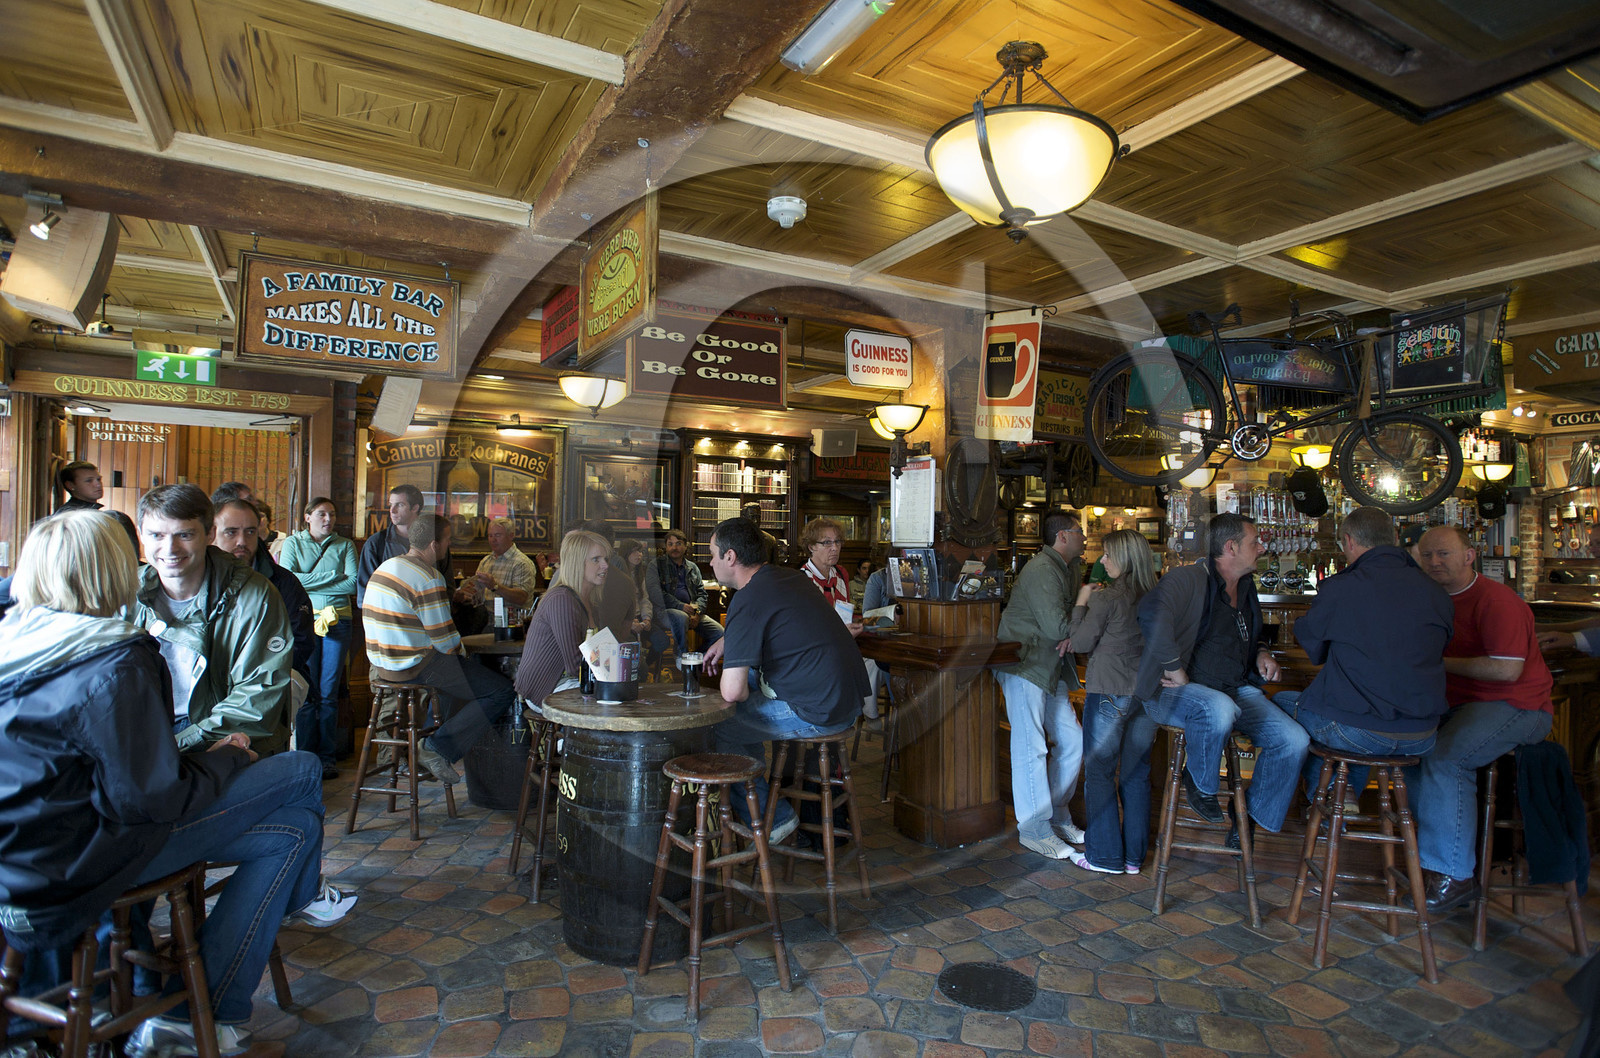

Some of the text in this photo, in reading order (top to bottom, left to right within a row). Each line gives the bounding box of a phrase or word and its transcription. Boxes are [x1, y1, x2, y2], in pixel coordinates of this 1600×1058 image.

[599, 232, 620, 272] WERE
[621, 229, 642, 267] HERE
[262, 272, 444, 317] A FAMILY BAR
[587, 309, 610, 337] WERE
[612, 274, 642, 325] BORN
[265, 298, 436, 336] MAKES ALL THE
[262, 321, 439, 363] DIFFERENCE
[640, 326, 779, 354] Be Good
[851, 338, 908, 364] GUINNESS
[692, 350, 732, 364] Or
[989, 355, 1013, 364] GUINNESS
[1584, 352, 1599, 368] 12
[641, 360, 777, 386] Be Gone
[852, 364, 908, 377] IS GOOD FOR YOU
[54, 376, 291, 410] GUINNESS EST. 1759
[1052, 393, 1075, 405] IRISH
[977, 414, 1032, 429] GUINNESS
[1047, 403, 1081, 418] MUSIC
[86, 421, 171, 434] QUIETNESS IS
[91, 432, 165, 443] POLITENESS
[1040, 422, 1070, 434] UPSTAIRS
[376, 439, 445, 465] Cantrell
[449, 443, 460, 457] &
[471, 517, 547, 539] WERS
